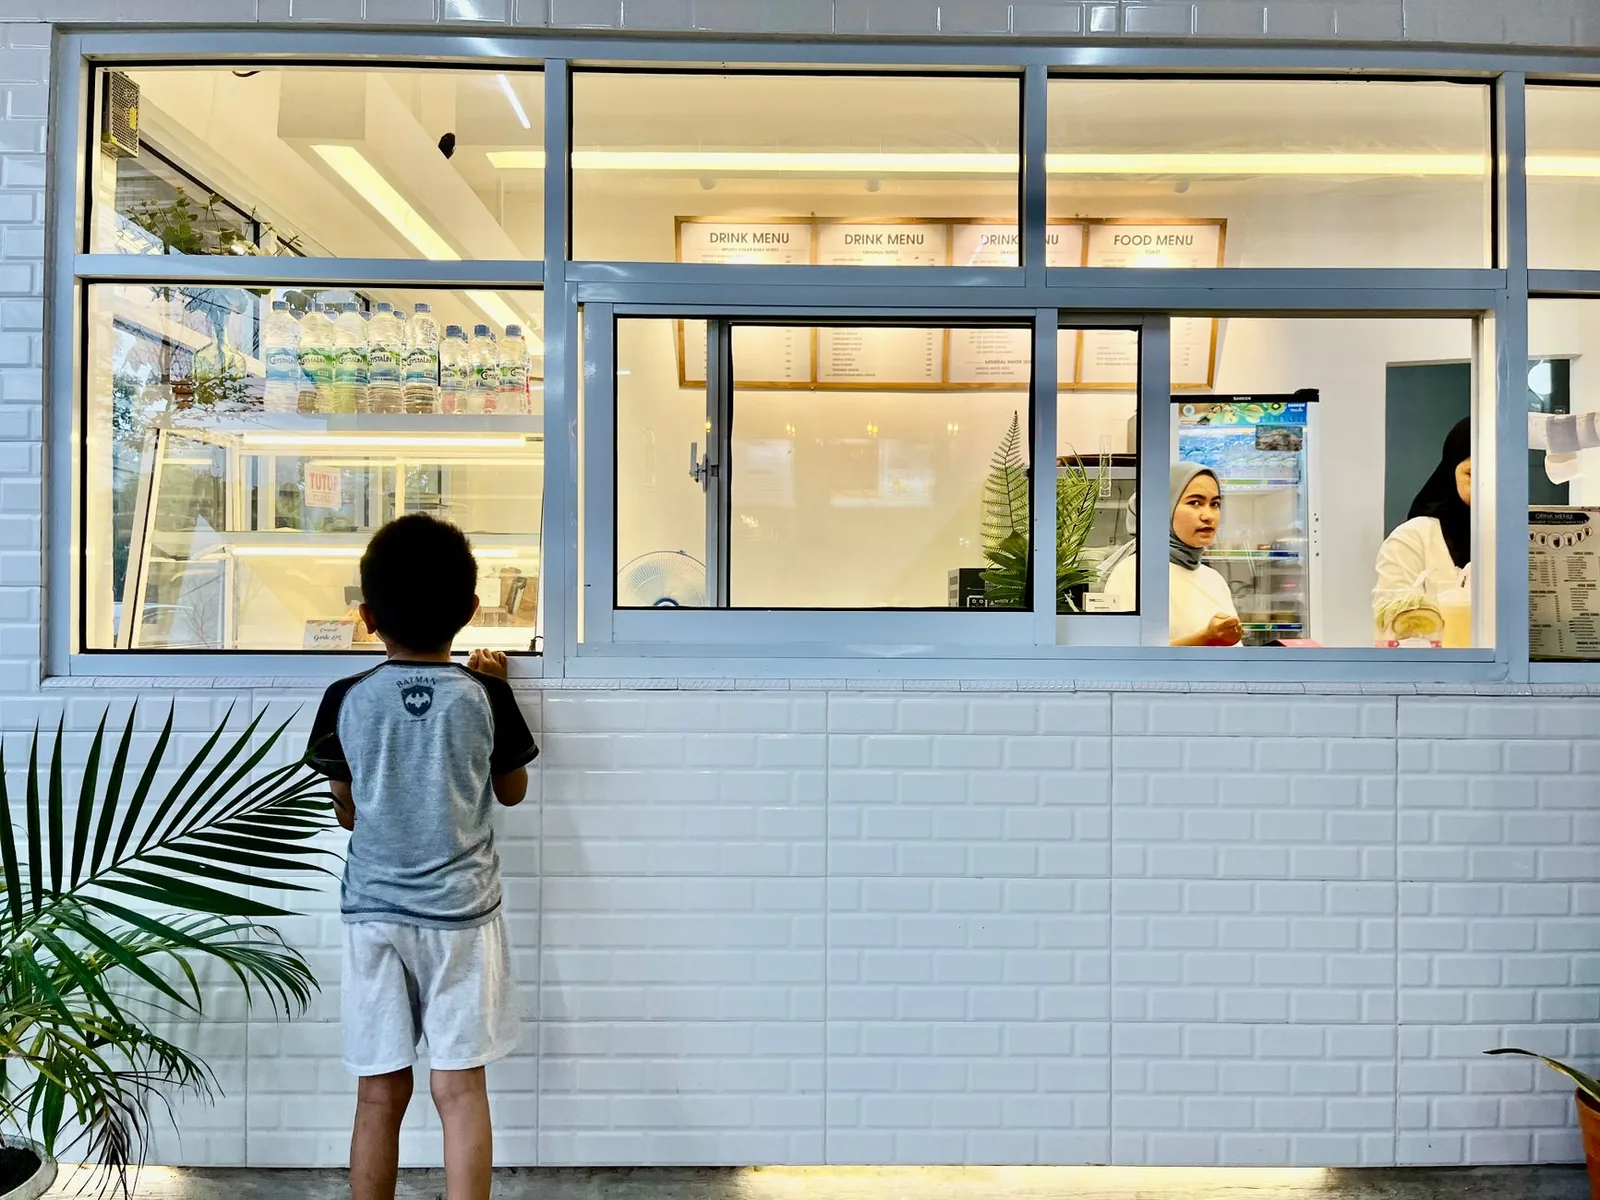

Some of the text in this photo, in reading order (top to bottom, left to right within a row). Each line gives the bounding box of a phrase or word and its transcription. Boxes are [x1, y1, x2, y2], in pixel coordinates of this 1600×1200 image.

[709, 232, 790, 244] DRINK MENU
[844, 234, 924, 245] DRINK MENU
[980, 234, 1019, 245] DRINK
[1113, 234, 1194, 246] FOOD MENU
[396, 676, 436, 689] BATMAN
